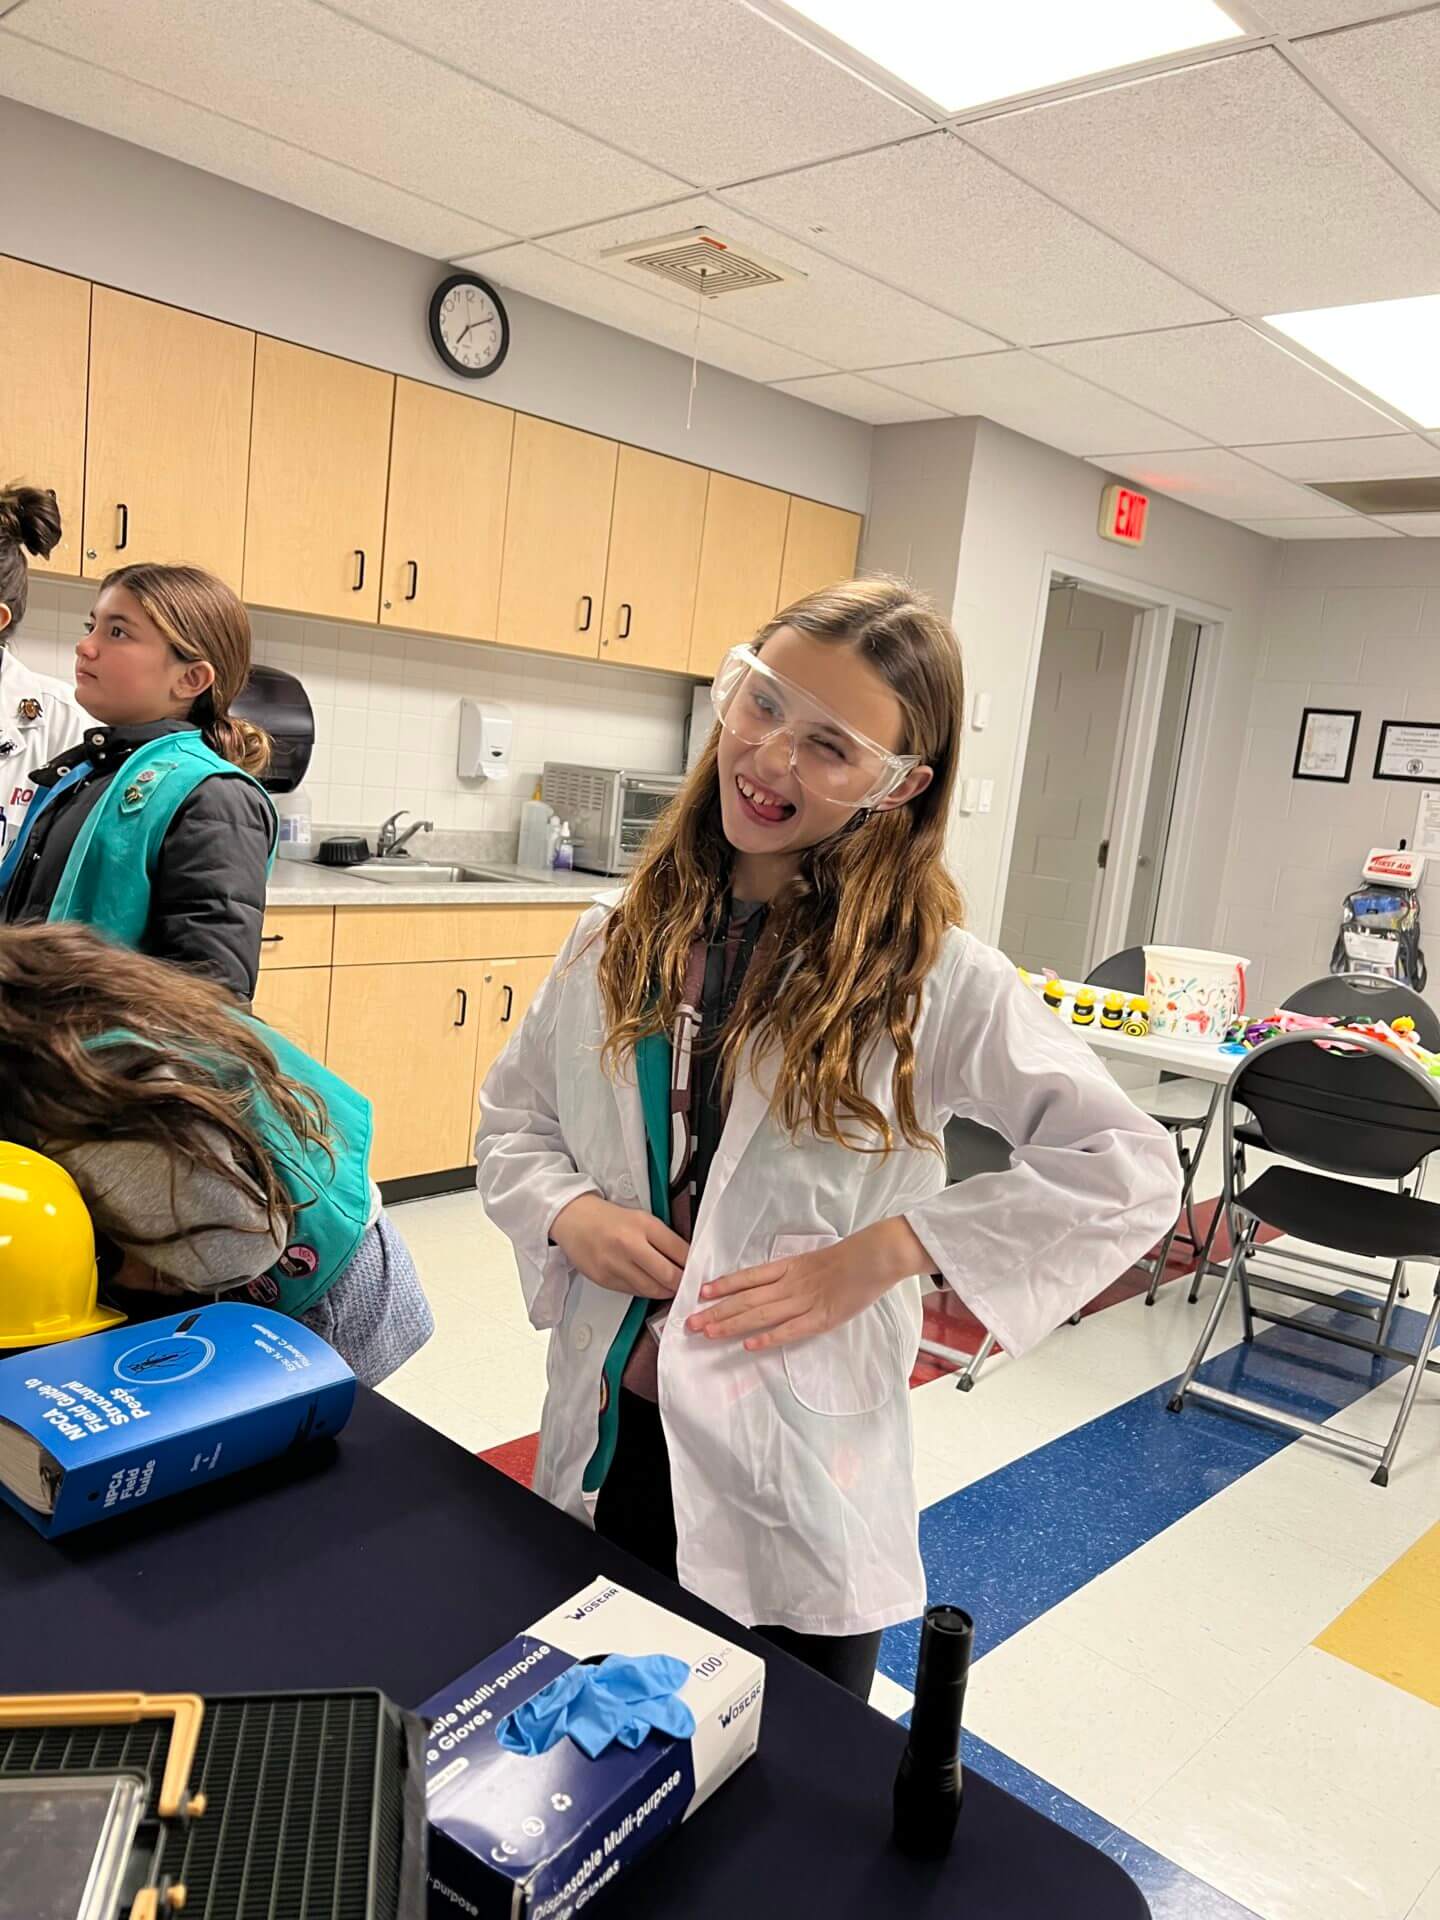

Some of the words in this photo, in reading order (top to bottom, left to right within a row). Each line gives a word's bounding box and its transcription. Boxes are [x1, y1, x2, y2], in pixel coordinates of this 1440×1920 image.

[1115, 490, 1147, 541] EXIT
[24, 1378, 43, 1389] to
[38, 1384, 75, 1407] Guide
[61, 1380, 129, 1425] Structural
[67, 1404, 109, 1434] Field
[110, 1388, 151, 1419] Pests
[42, 1408, 88, 1441] NPCA
[103, 1468, 126, 1508] NPCA
[119, 1467, 141, 1500] Field
[134, 1459, 156, 1497] Guide
[455, 1645, 551, 1715] Multi-purpose
[695, 1656, 723, 1677] 100
[438, 1709, 493, 1750] Gloves
[532, 1849, 602, 1920] Disposable
[603, 1770, 681, 1857] Multi-purpose
[576, 1860, 620, 1910] Gloves
